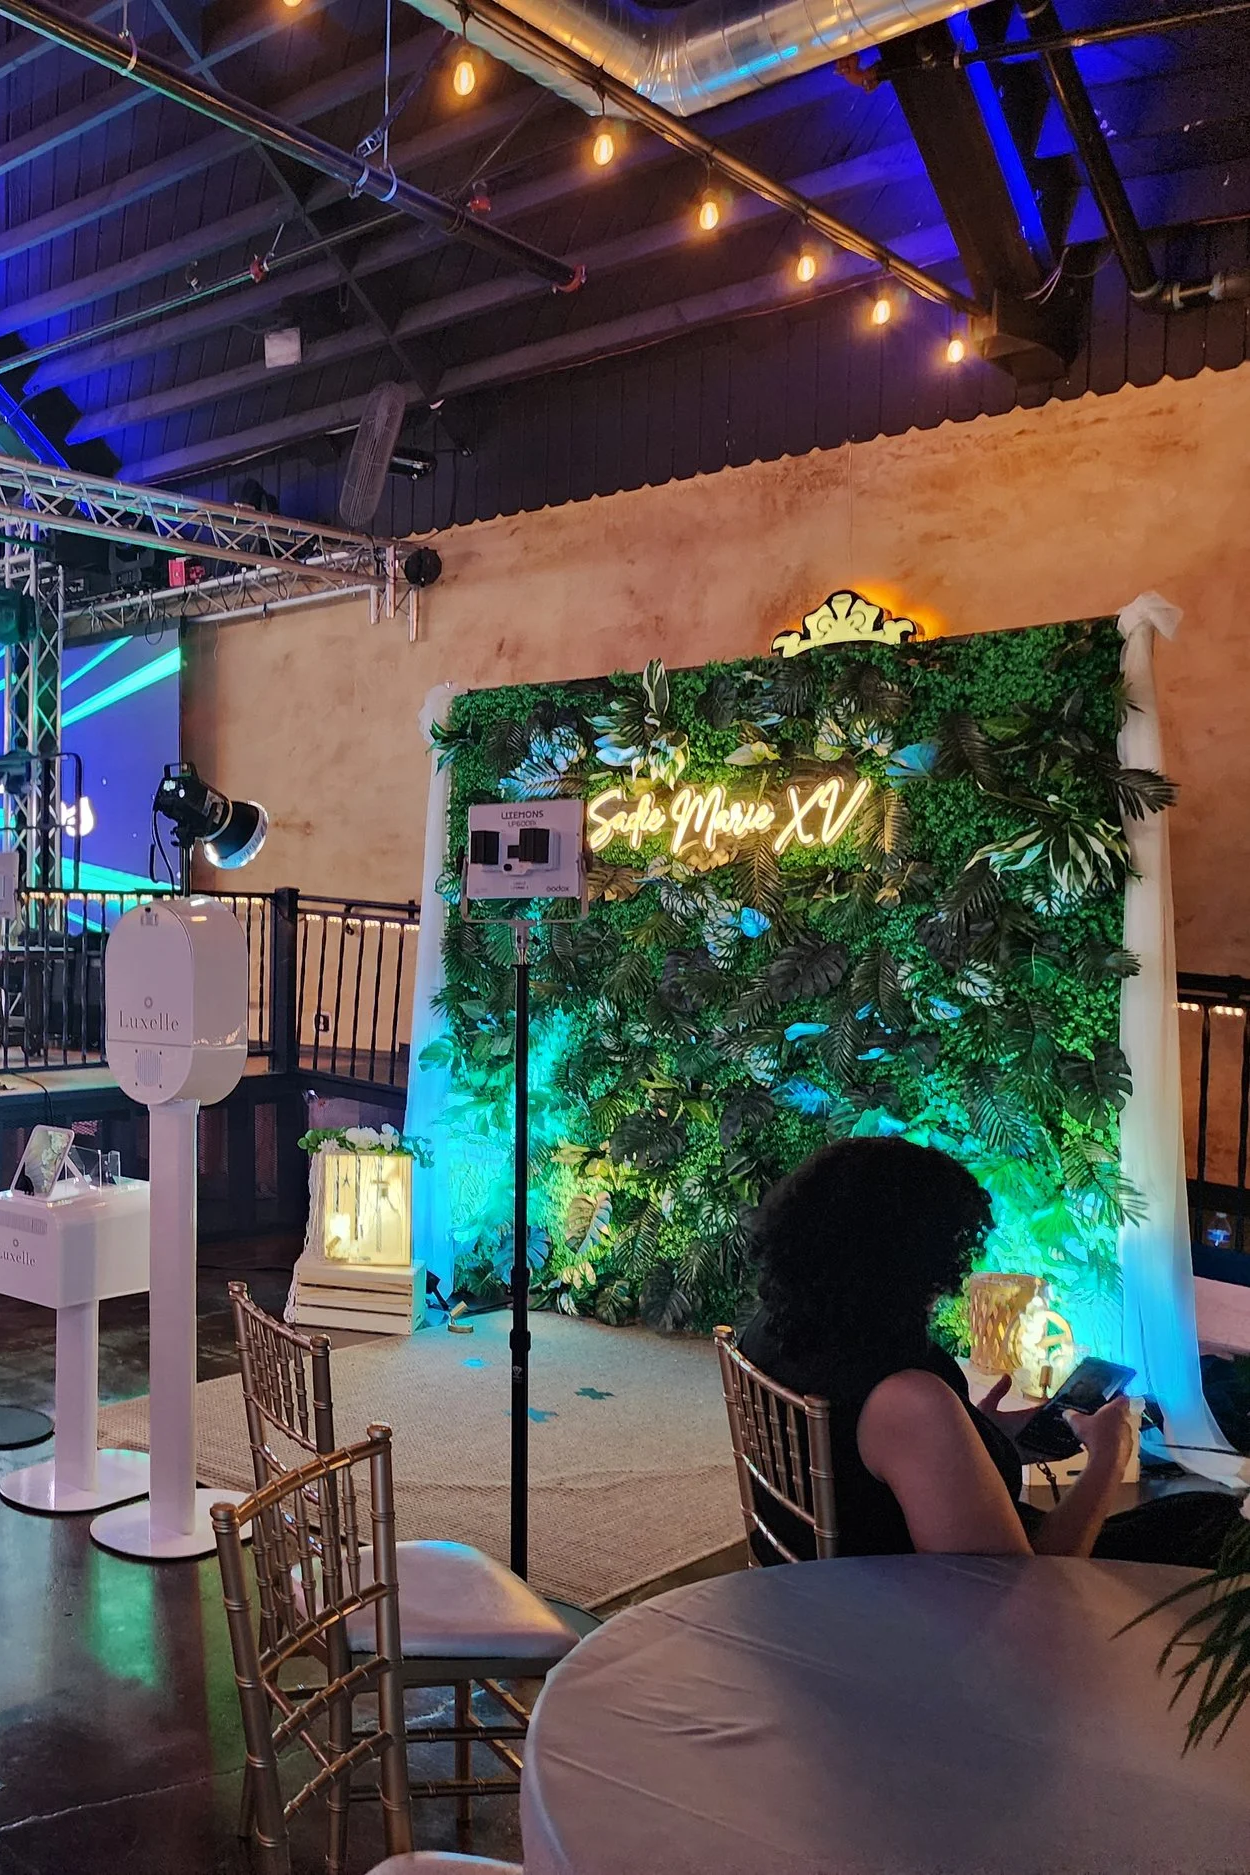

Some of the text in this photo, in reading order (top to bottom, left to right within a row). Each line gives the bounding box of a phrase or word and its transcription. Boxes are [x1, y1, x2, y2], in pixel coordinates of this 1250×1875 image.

[501, 809, 544, 820] LITEMONS
[670, 784, 776, 854] Marie
[773, 778, 871, 854] XV
[118, 1009, 180, 1033] Luxelle
